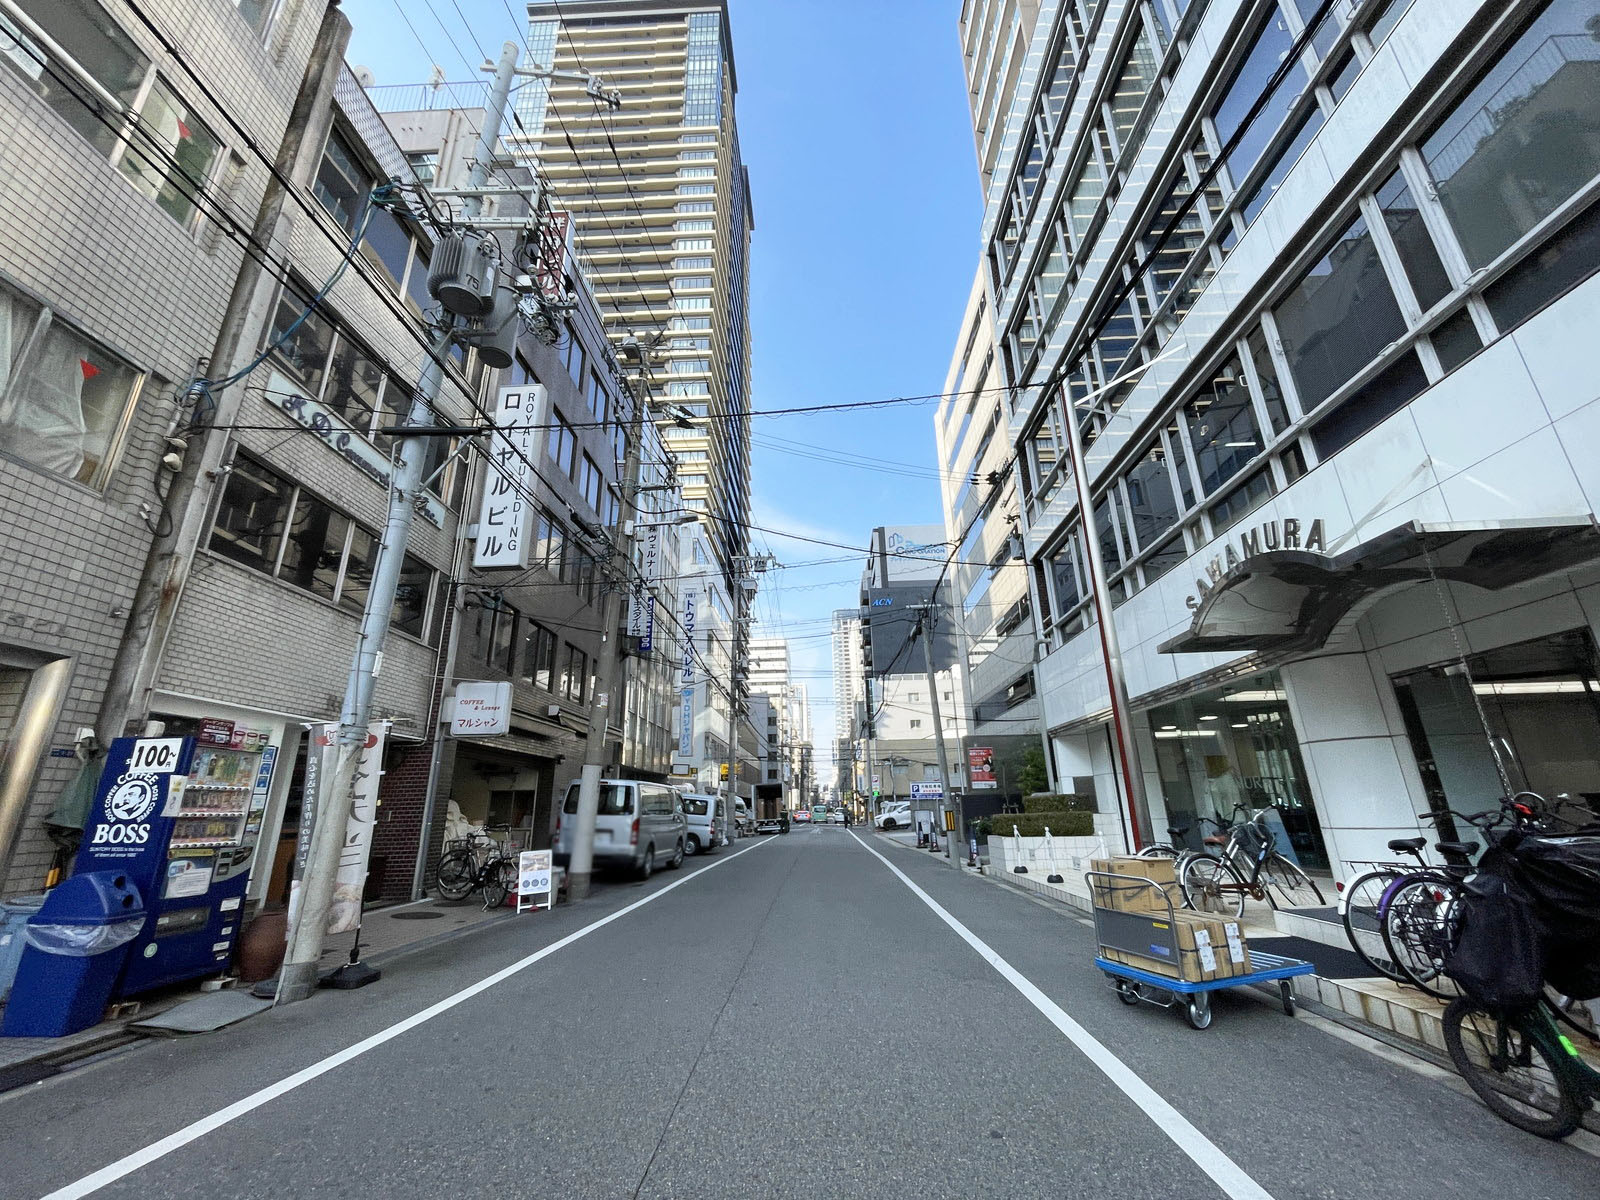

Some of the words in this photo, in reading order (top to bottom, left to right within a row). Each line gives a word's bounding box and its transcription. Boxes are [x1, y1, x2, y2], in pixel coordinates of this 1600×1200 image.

[465, 273, 480, 290] 75
[482, 393, 522, 557] ロイヤルビル
[1185, 518, 1327, 611] SAWAMURA
[872, 598, 894, 606] ACN
[458, 717, 499, 728] マルシャン
[92, 823, 151, 844] BOSS
